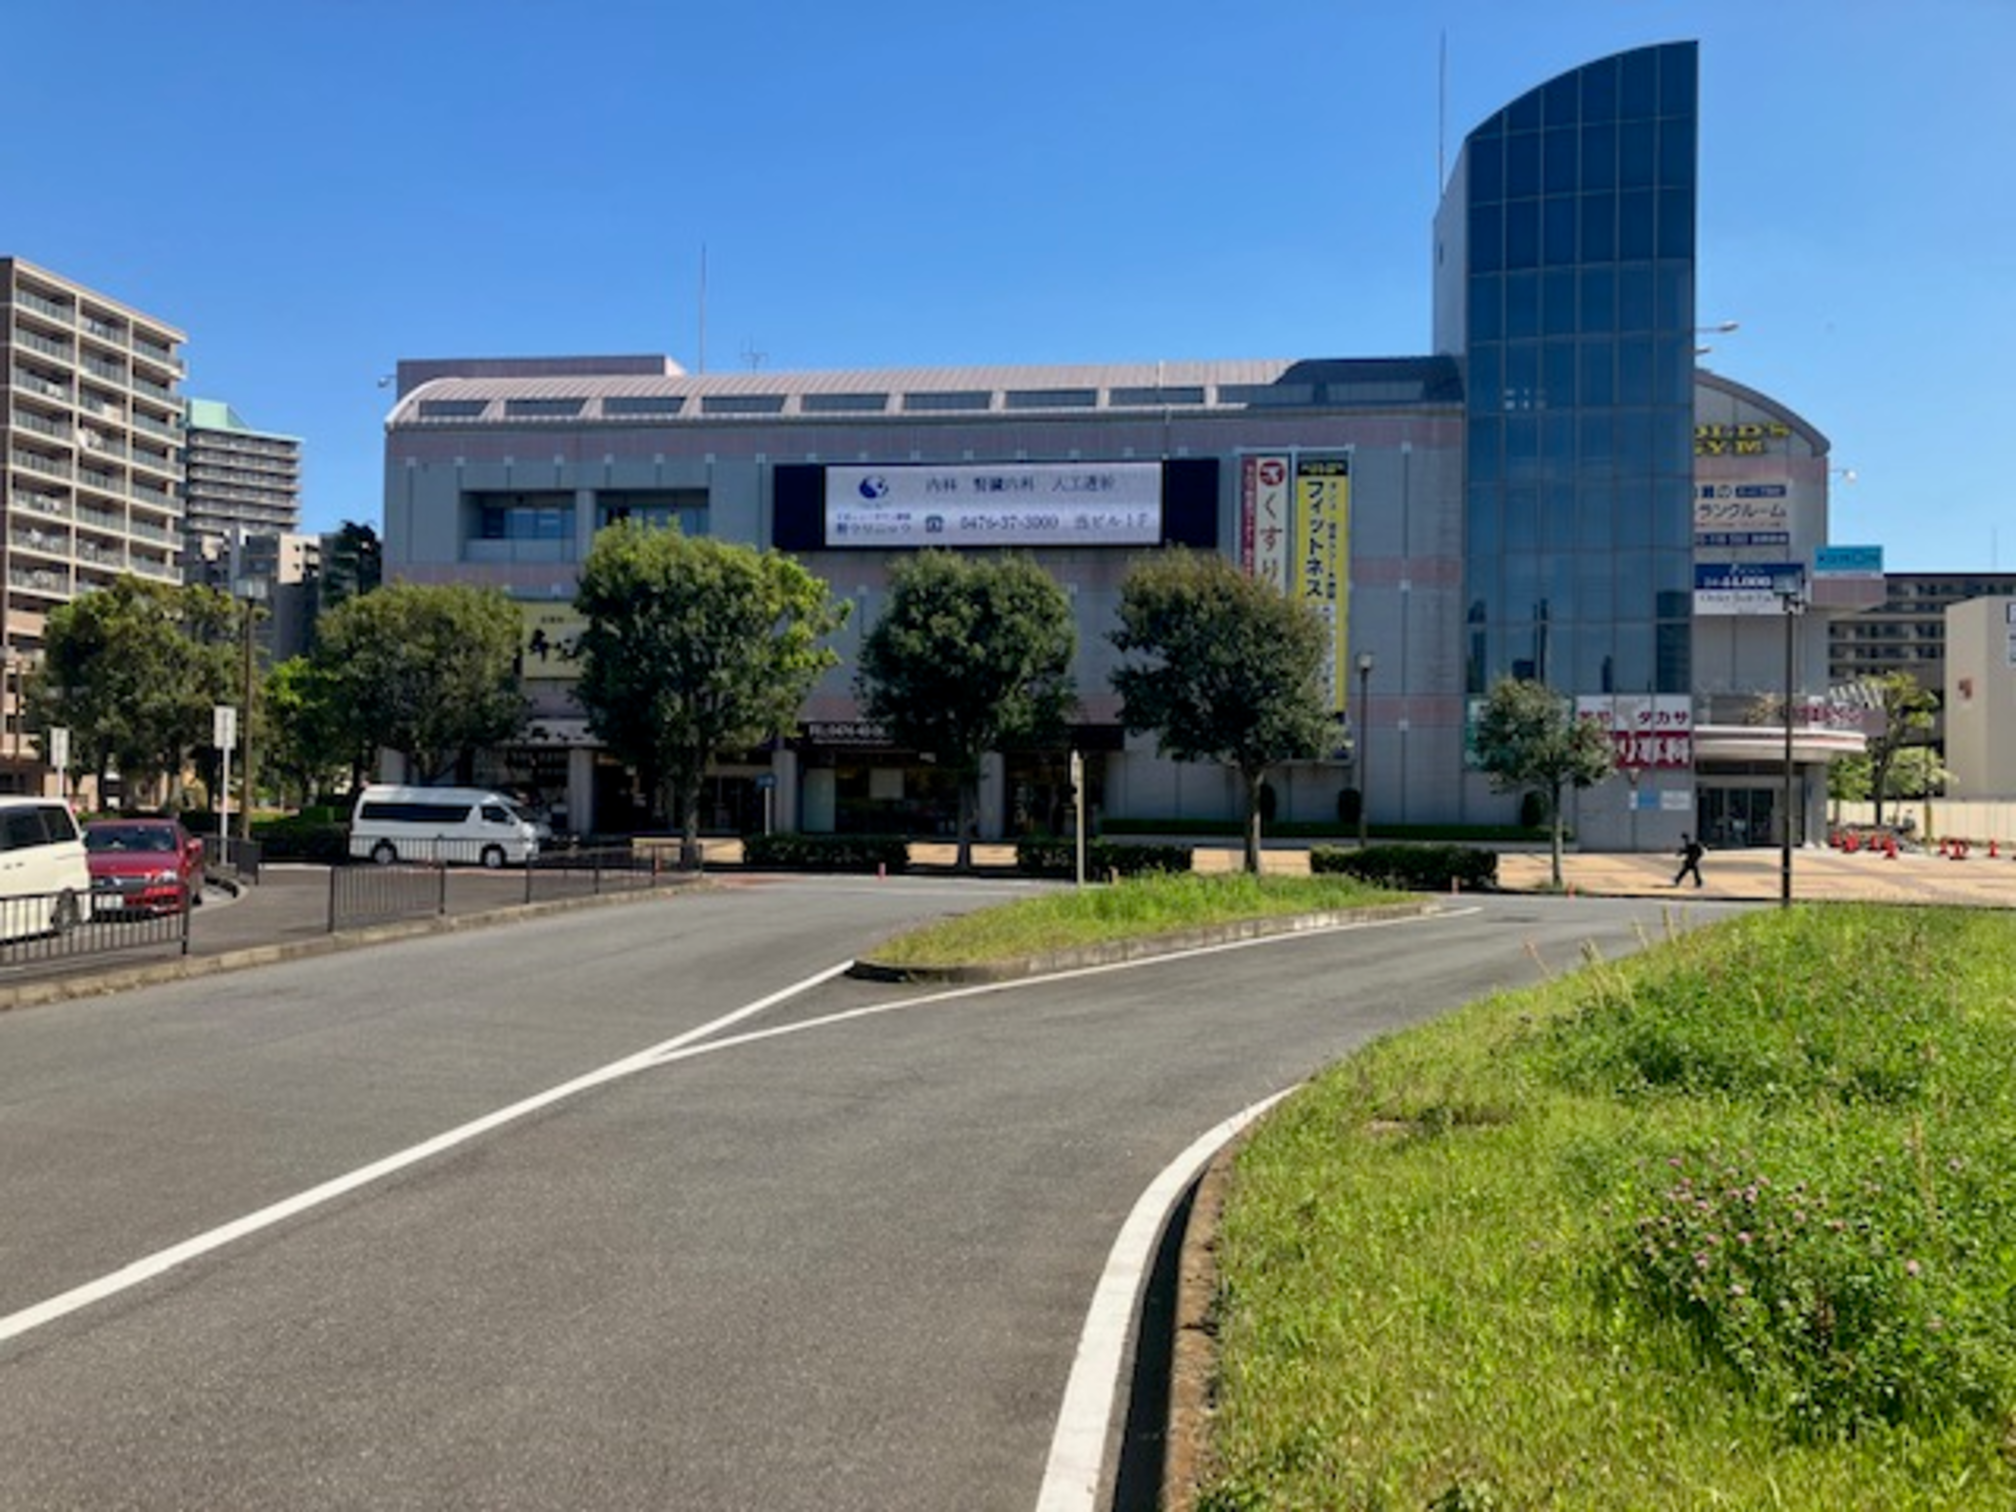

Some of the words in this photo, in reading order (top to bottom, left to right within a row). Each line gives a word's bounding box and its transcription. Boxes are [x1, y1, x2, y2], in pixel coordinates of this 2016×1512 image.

[1259, 492, 1284, 583] くすり
[1306, 480, 1325, 598] フィットネス
